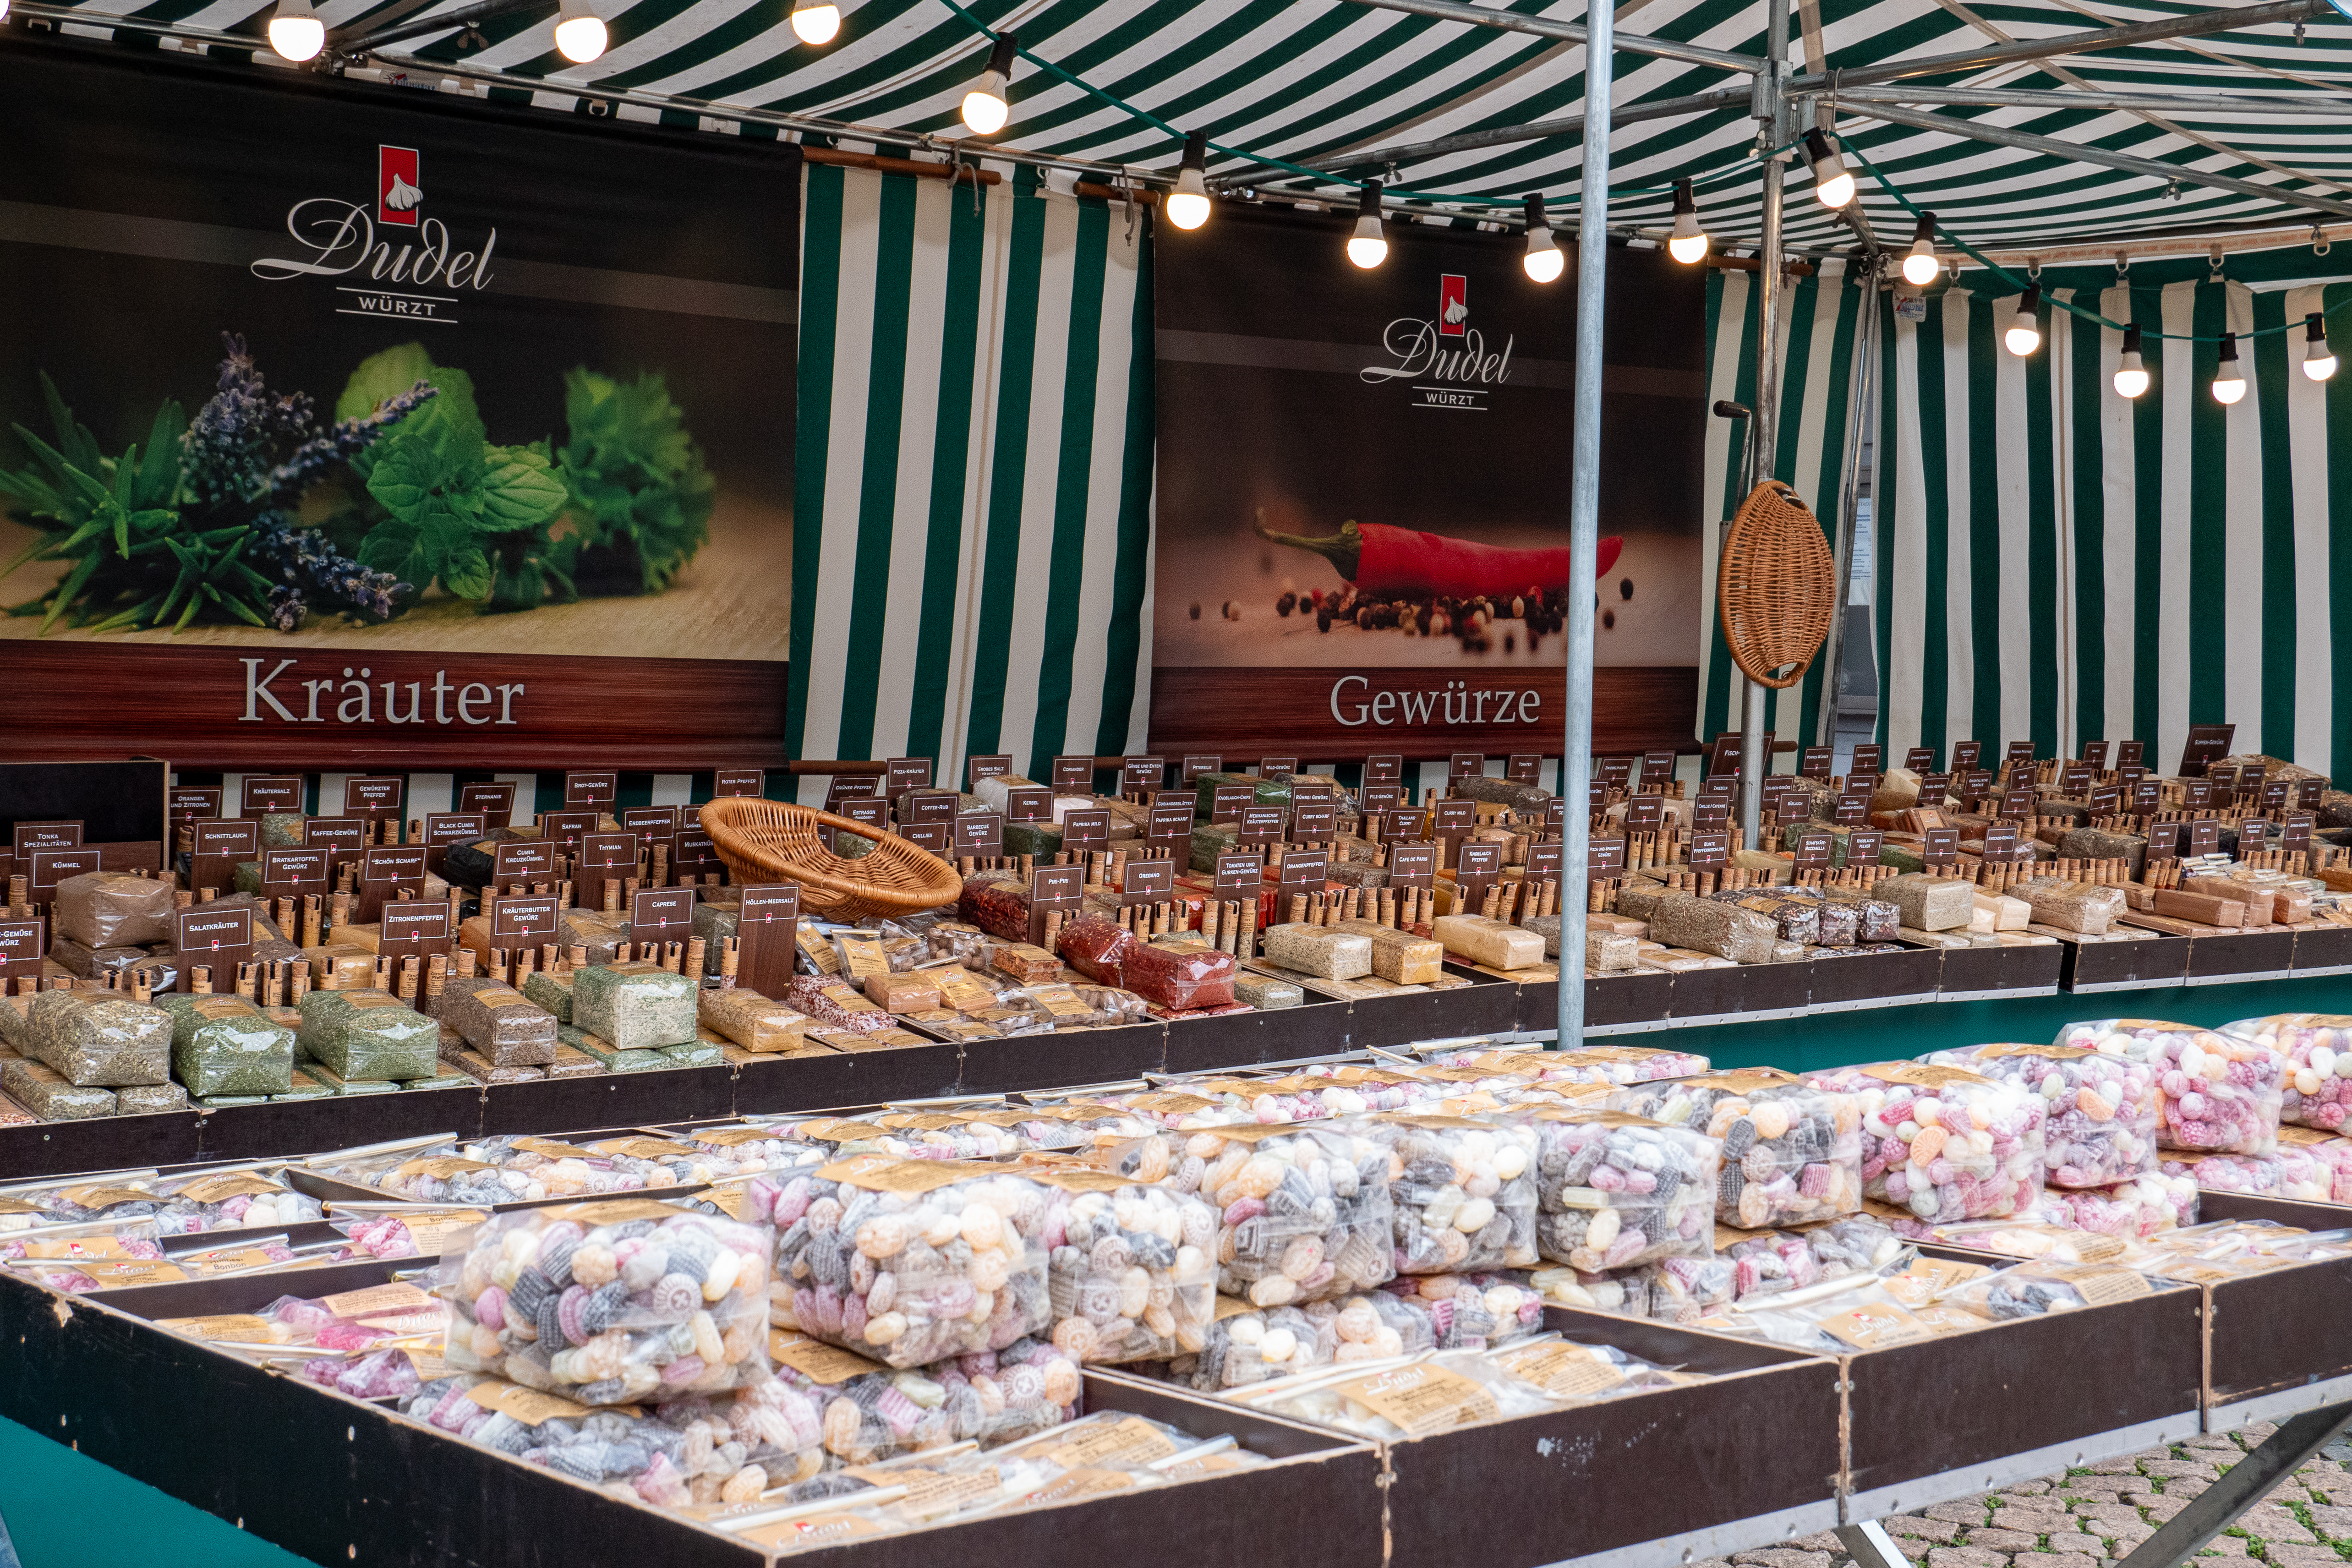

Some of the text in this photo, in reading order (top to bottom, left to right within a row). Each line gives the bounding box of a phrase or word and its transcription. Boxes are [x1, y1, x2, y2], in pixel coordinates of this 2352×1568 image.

[251, 198, 495, 290] Dudel
[358, 296, 435, 316] WÜRZT
[1360, 318, 1512, 383] Dudel
[1426, 392, 1474, 405] WÜRZT
[238, 658, 524, 724] Kräuter
[1330, 676, 1540, 726] Gewürze
[190, 922, 238, 931] SALATKRÄUTER
[213, 1261, 247, 1270] Bonbon
[1849, 1314, 1900, 1339] Dudel
